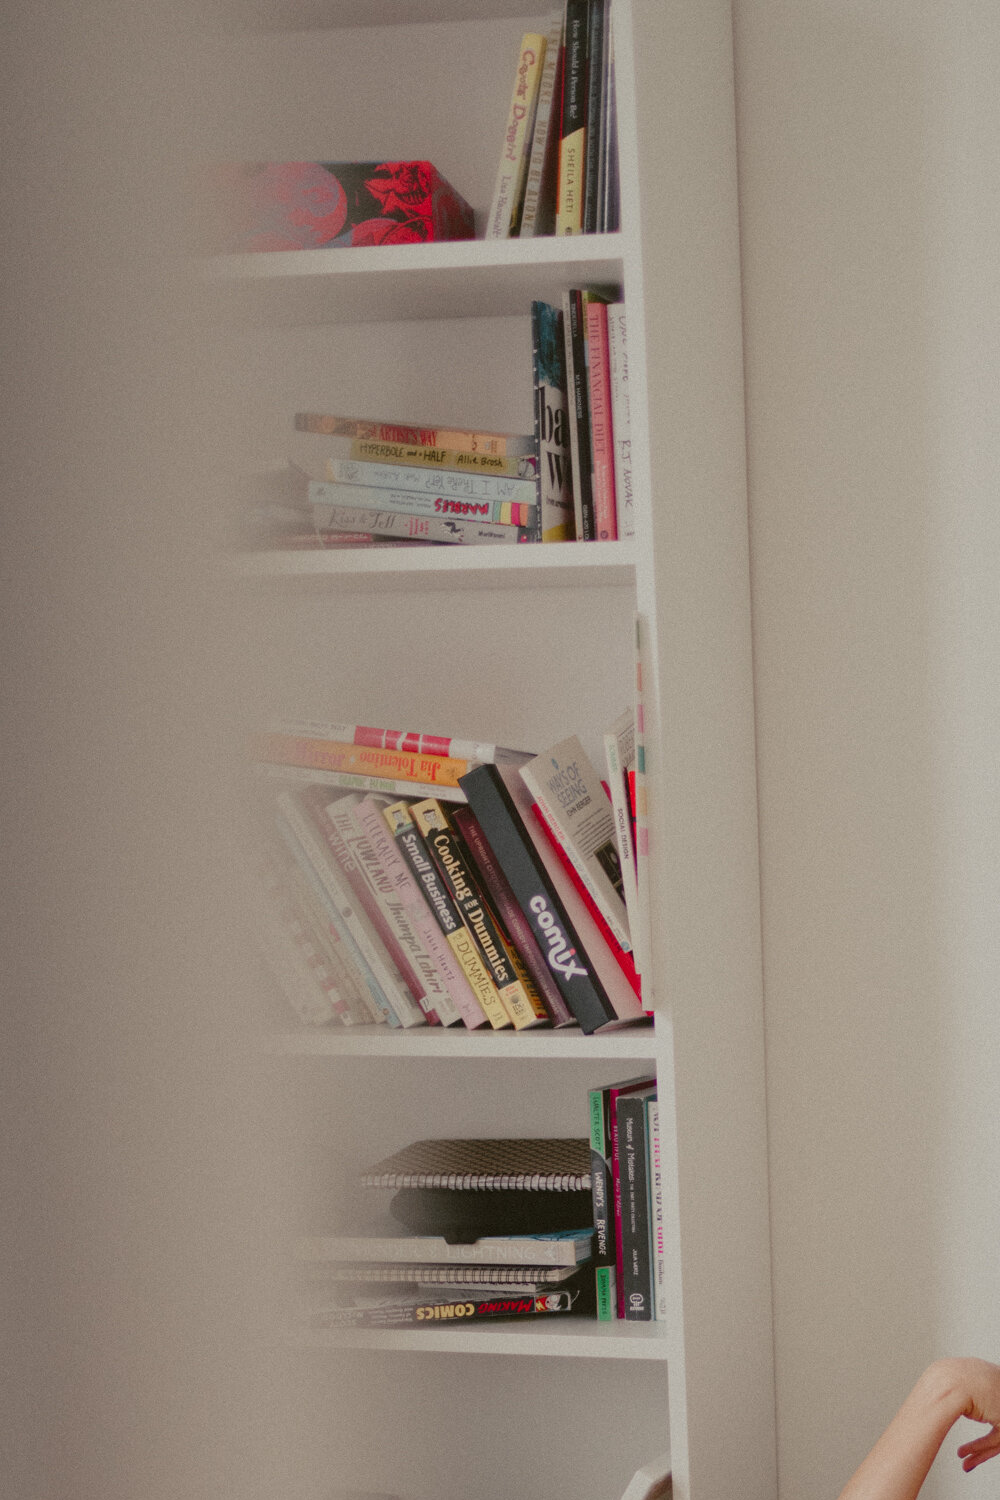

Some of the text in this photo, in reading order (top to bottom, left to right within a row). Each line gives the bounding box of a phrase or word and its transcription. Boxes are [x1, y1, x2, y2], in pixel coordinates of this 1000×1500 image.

[571, 20, 580, 38] How
[571, 41, 580, 69] Should
[570, 76, 579, 103] Person
[535, 121, 549, 145] HOW
[566, 148, 576, 213] SHEILA HETI
[523, 190, 539, 229] ALONE
[588, 314, 600, 342] THE
[590, 347, 604, 417] FINANCIAL
[379, 425, 418, 445] ARTIST'S
[419, 430, 438, 448] WAY
[594, 423, 606, 455] DIET
[360, 443, 404, 458] HYPERBOLE
[423, 450, 447, 462] HALF
[457, 454, 479, 465] Allie
[480, 456, 503, 467] Brosh
[496, 483, 516, 495] AM
[623, 471, 633, 508] NOVAK
[434, 497, 490, 515] MARBLES
[359, 752, 441, 781] Jia Tolentino
[547, 761, 581, 794] WAYS OF
[556, 778, 588, 805] SEEING
[617, 808, 630, 860] SOCIAL DESIGN
[326, 832, 356, 872] wine
[467, 824, 478, 838] THE
[473, 837, 490, 865] UPRIGHT
[510, 918, 527, 944] COMEDY
[333, 813, 442, 994] THE LOWLAND Jhumpa Lahiri
[402, 832, 497, 1006] Small Business DUMMIES
[433, 833, 472, 901] Cooking
[468, 906, 510, 983] Dummies
[529, 894, 589, 982] comix
[625, 1117, 634, 1142] Museum
[593, 1171, 604, 1207] WENDY'S
[596, 1217, 607, 1256] REVENGE
[415, 1302, 475, 1320] COMICS
[477, 1298, 534, 1314] MAKING
